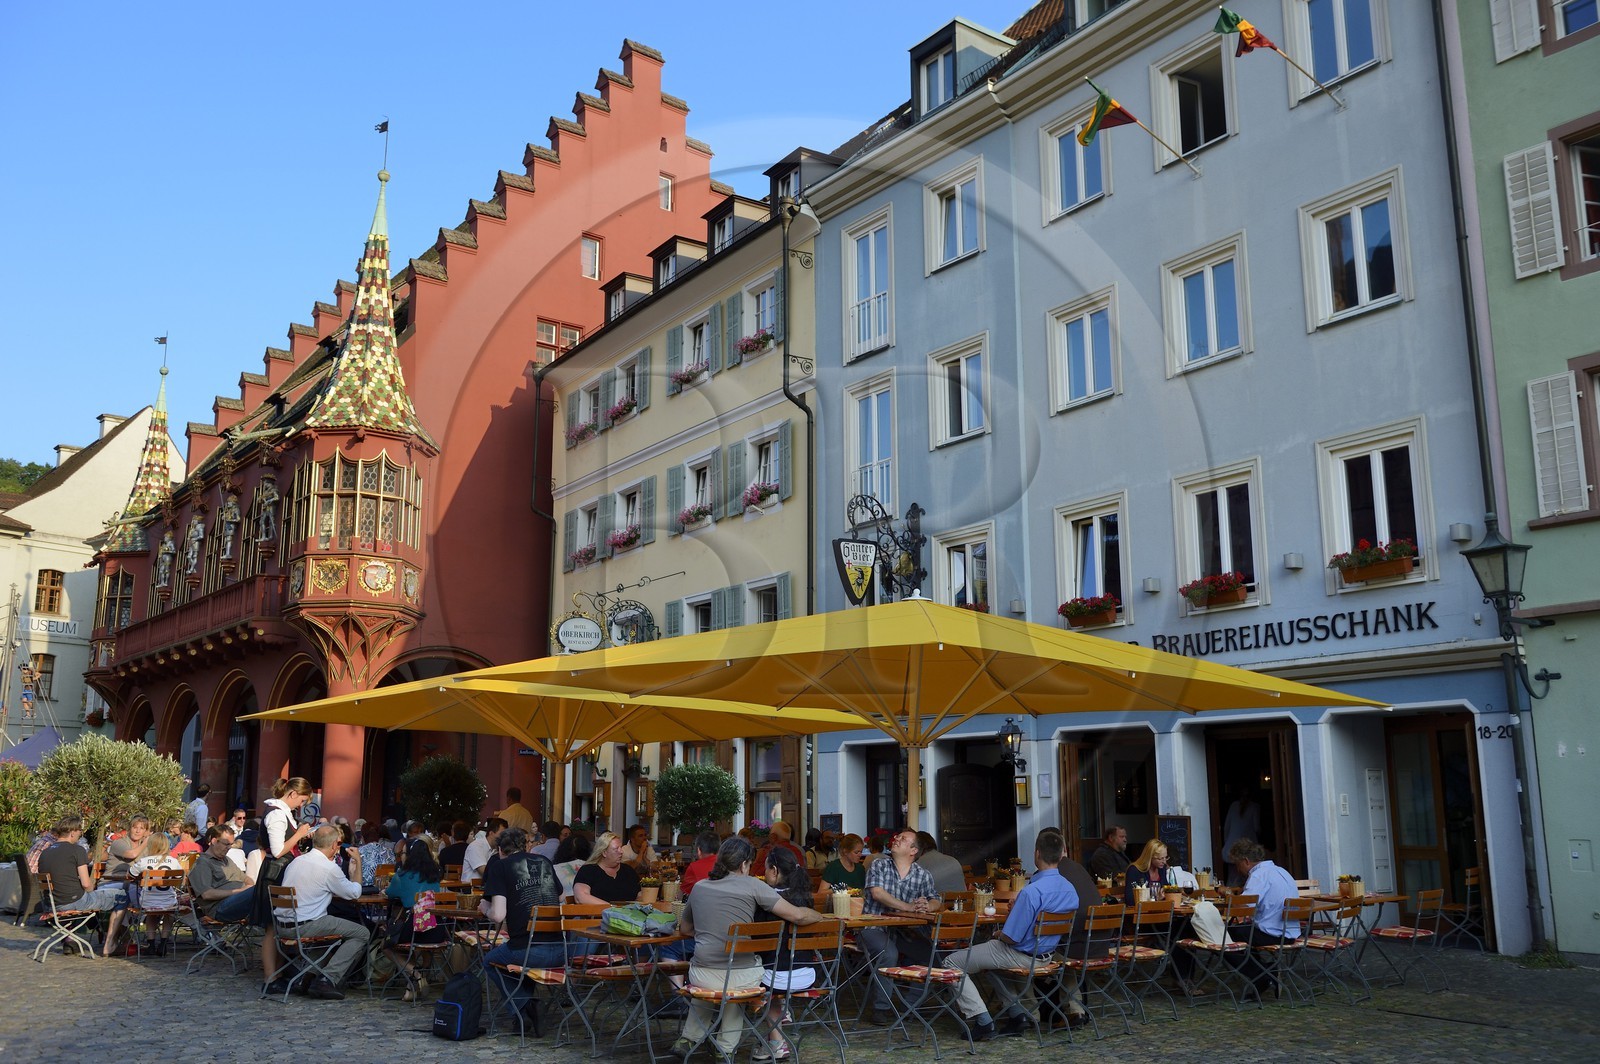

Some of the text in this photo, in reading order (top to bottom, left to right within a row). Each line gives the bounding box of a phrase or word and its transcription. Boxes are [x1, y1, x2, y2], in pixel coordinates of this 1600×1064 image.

[21, 617, 77, 635] USEUM
[1152, 602, 1438, 656] BRAUEREIAUSSCHANK
[560, 630, 600, 639] OBERKIRCH
[1477, 724, 1514, 740] 18-20
[147, 856, 172, 864] MÜER
